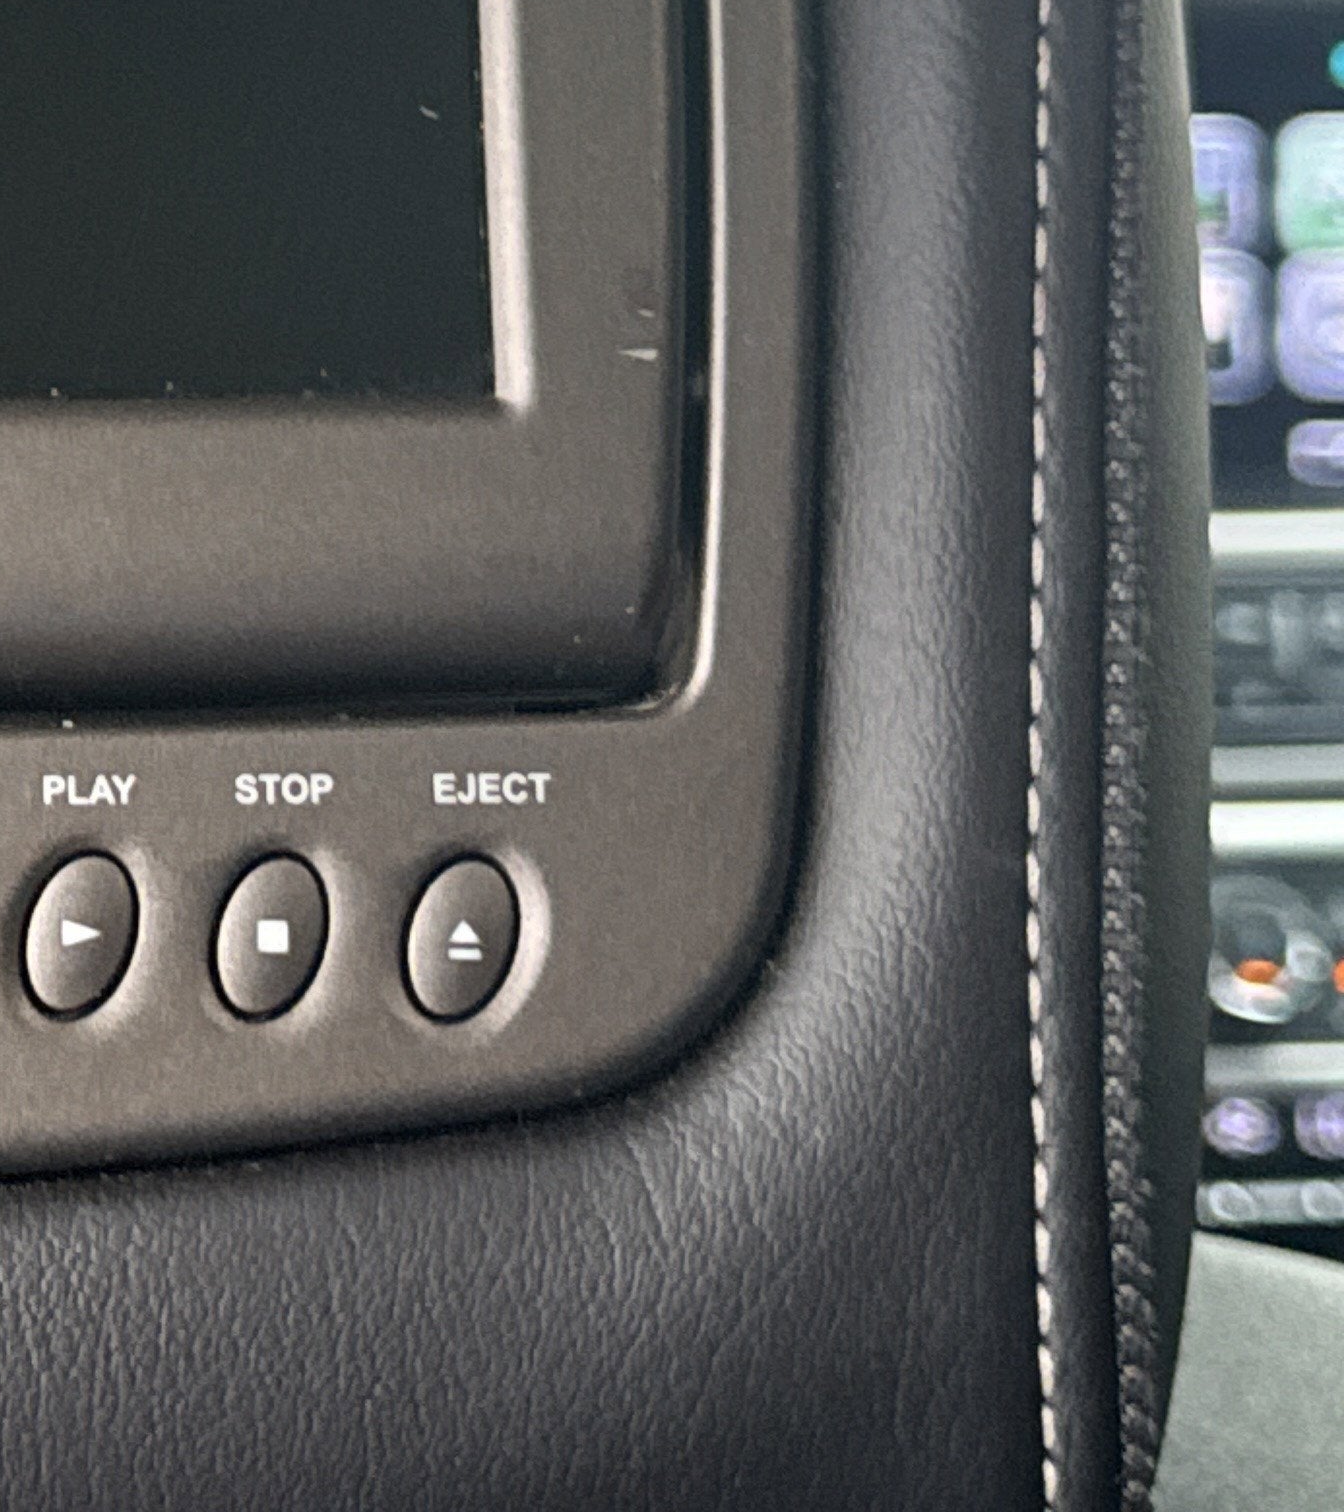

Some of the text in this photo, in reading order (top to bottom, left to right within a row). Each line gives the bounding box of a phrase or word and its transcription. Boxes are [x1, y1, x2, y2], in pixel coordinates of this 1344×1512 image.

[43, 774, 137, 806] PLAY
[234, 773, 334, 806] STOP
[433, 772, 552, 805] EJECT
